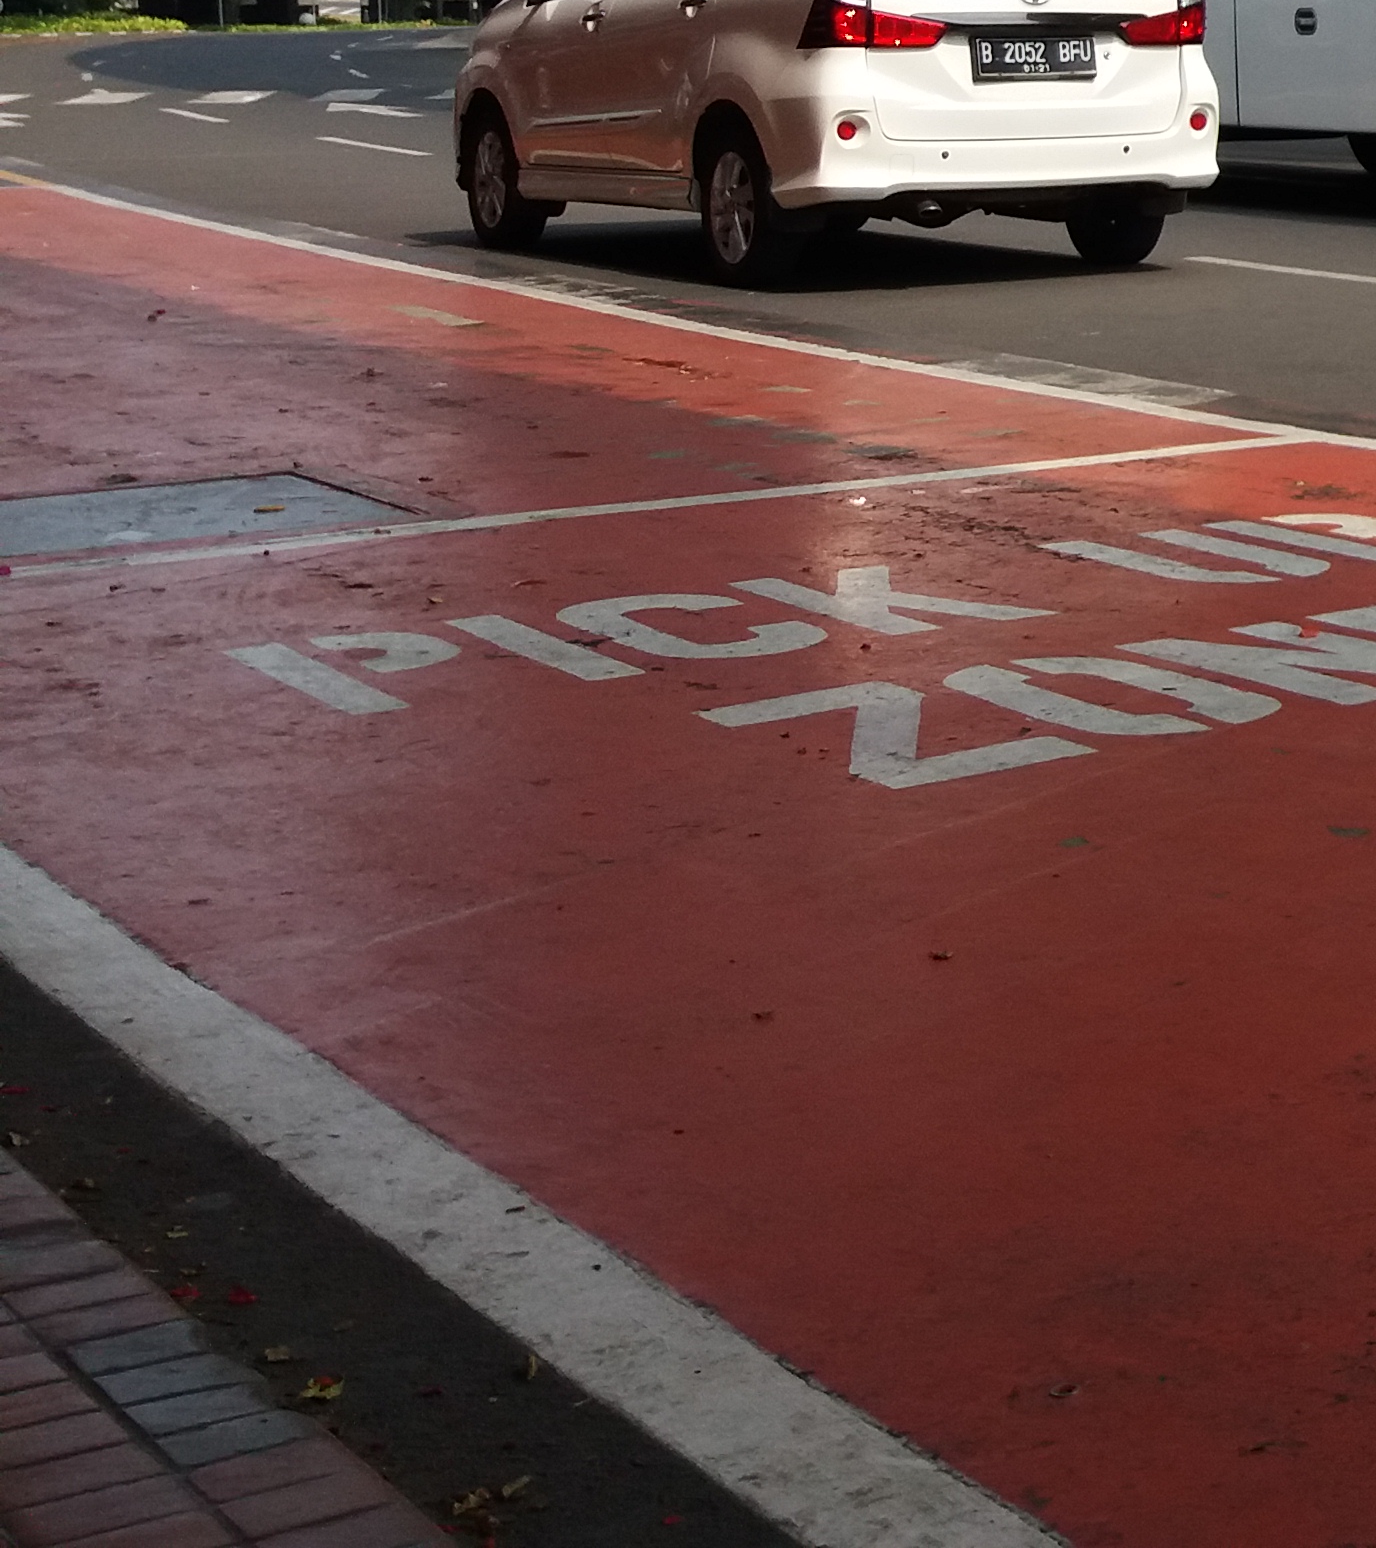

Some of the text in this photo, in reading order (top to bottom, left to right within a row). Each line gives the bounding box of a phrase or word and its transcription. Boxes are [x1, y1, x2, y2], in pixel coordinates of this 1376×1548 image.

[981, 40, 1092, 64] B 2052 BFU
[224, 565, 1057, 715] PICK
